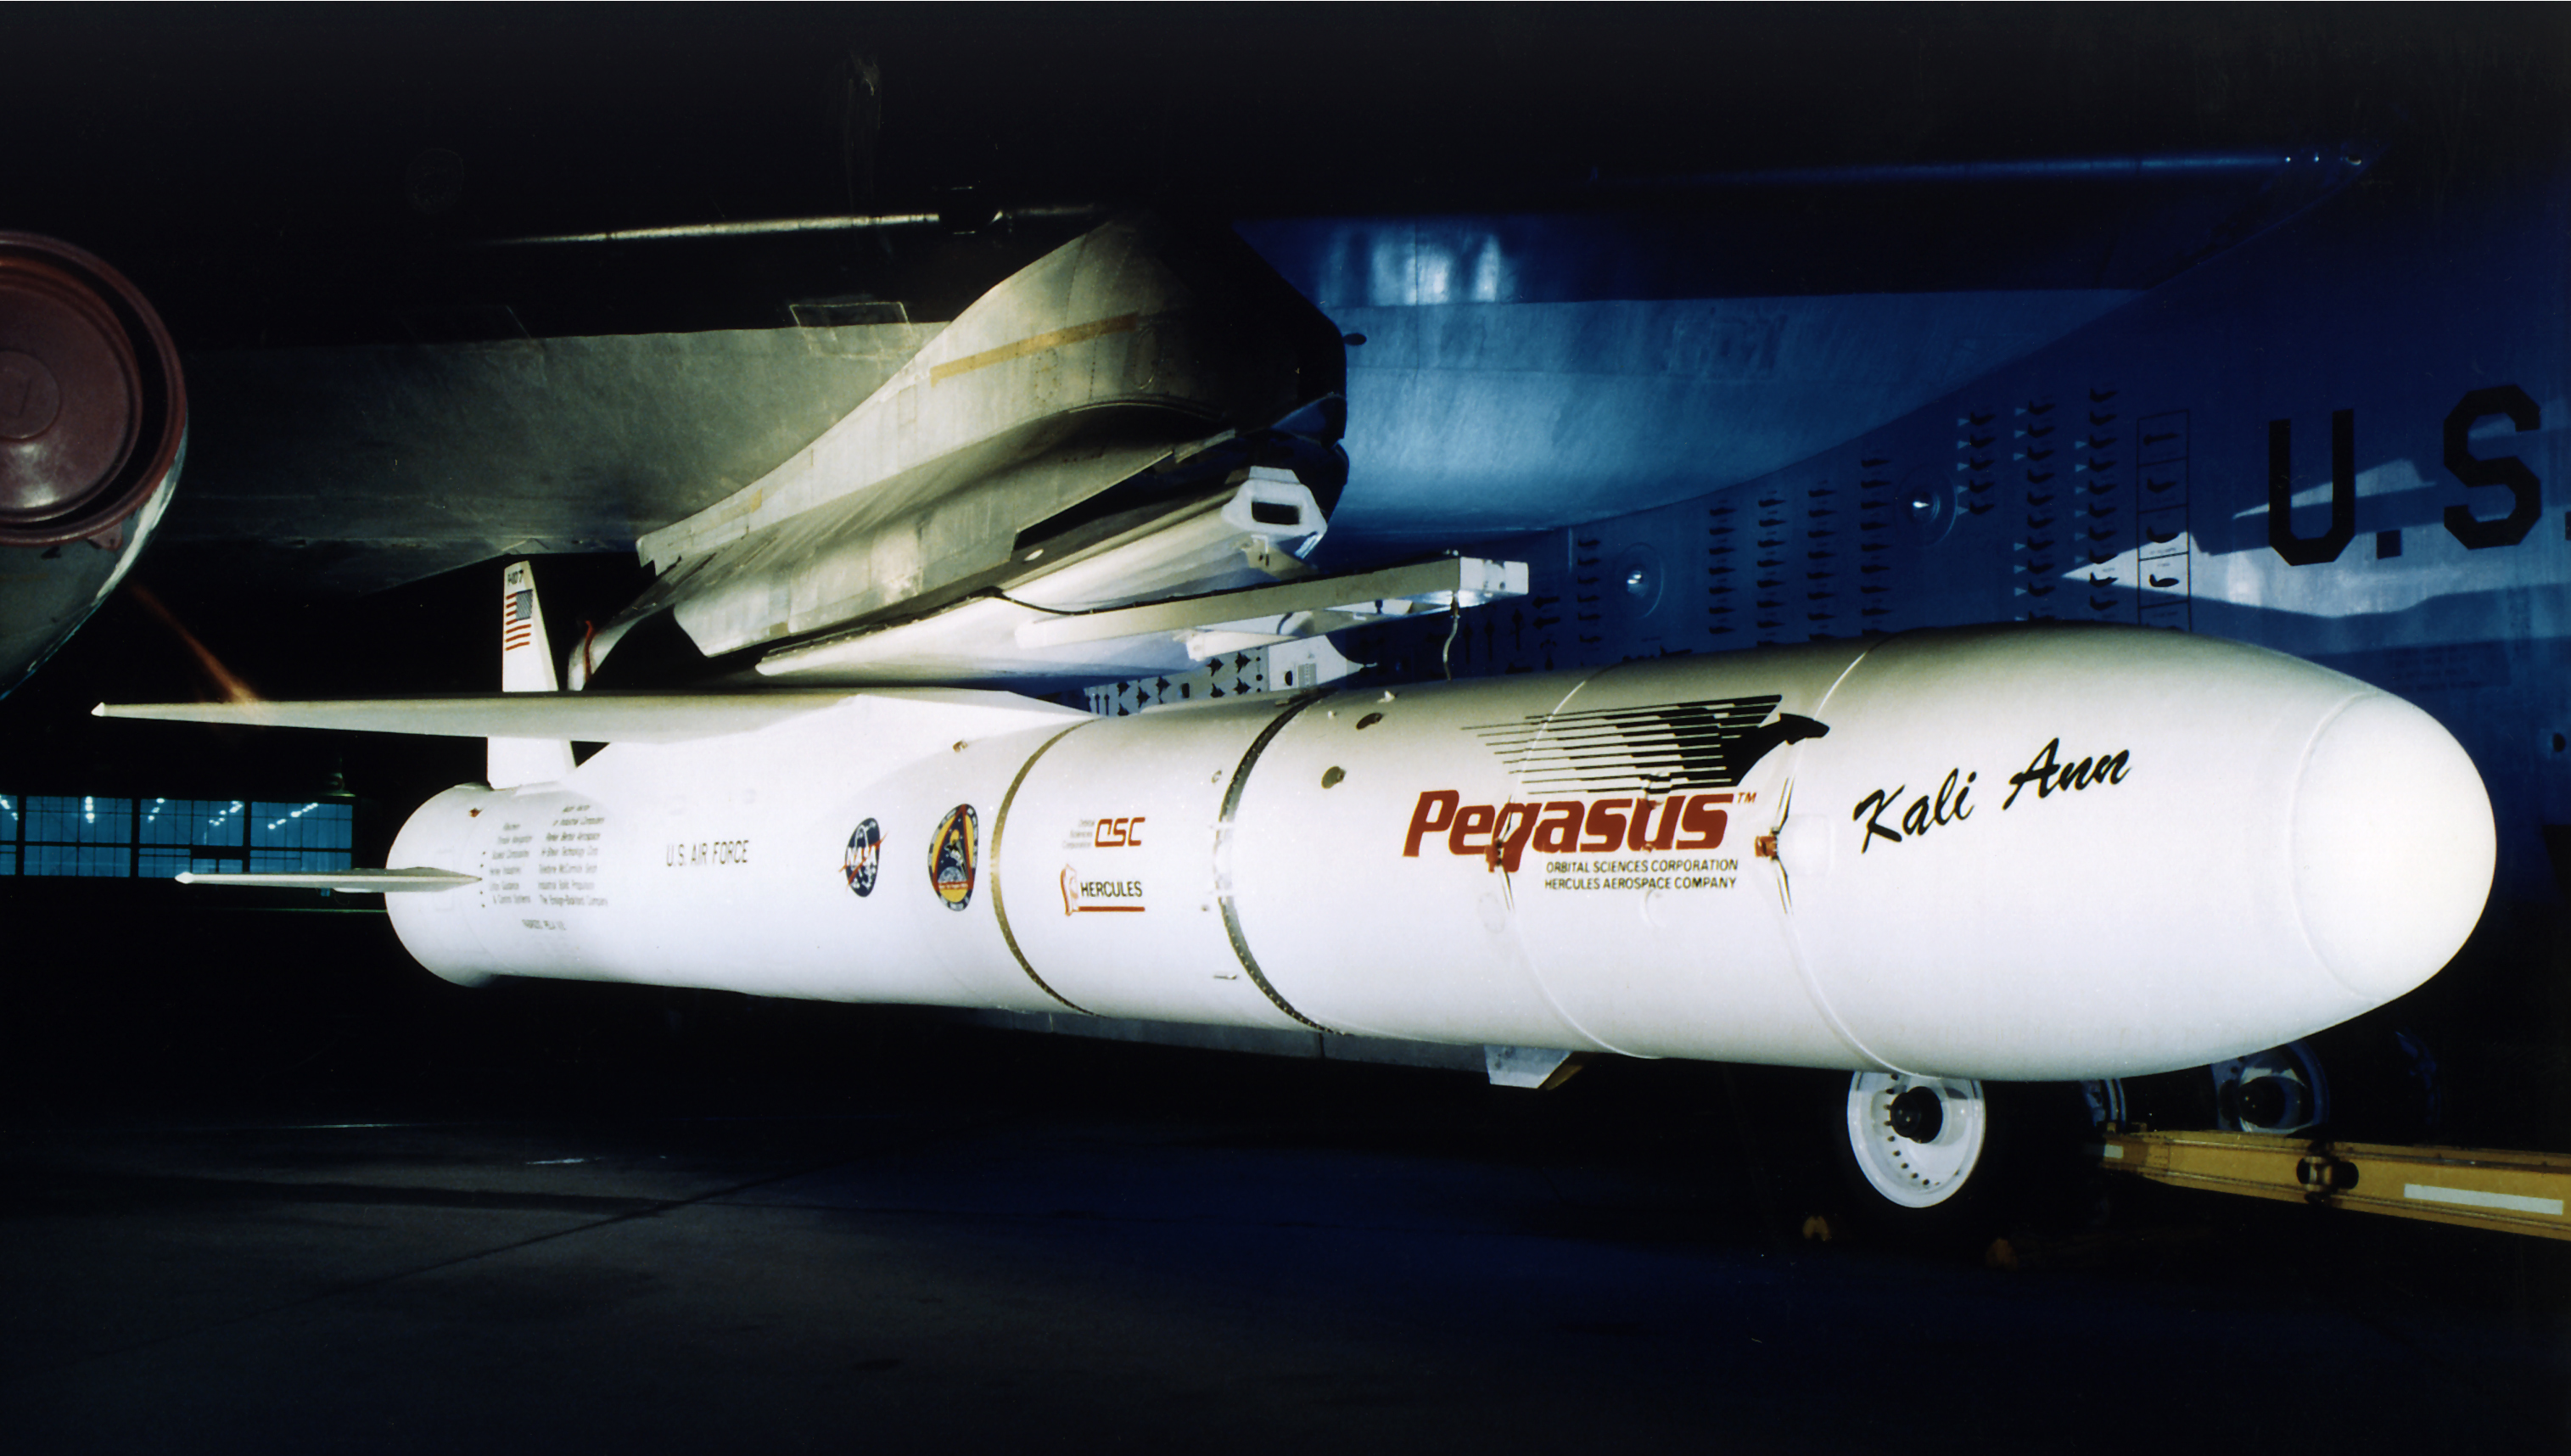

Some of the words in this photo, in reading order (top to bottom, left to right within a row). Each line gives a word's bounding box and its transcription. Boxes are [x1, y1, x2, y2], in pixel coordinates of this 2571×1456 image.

[2269, 384, 2571, 566] U.S
[1853, 768, 1977, 854] Kali
[2002, 736, 2133, 811] Ann
[1403, 789, 1734, 873] Pegasus
[690, 843, 709, 865] AIR
[712, 839, 750, 865] FORCE
[1546, 860, 1590, 873] ORBITAL
[1593, 860, 1649, 873] SCIENCES
[1650, 859, 1739, 872] CORPORATION
[1080, 881, 1143, 898] HERCULES
[1544, 877, 1600, 890] HERCULES
[1603, 876, 1671, 890] AEROSPACE
[1674, 876, 1737, 889] COMPANY
